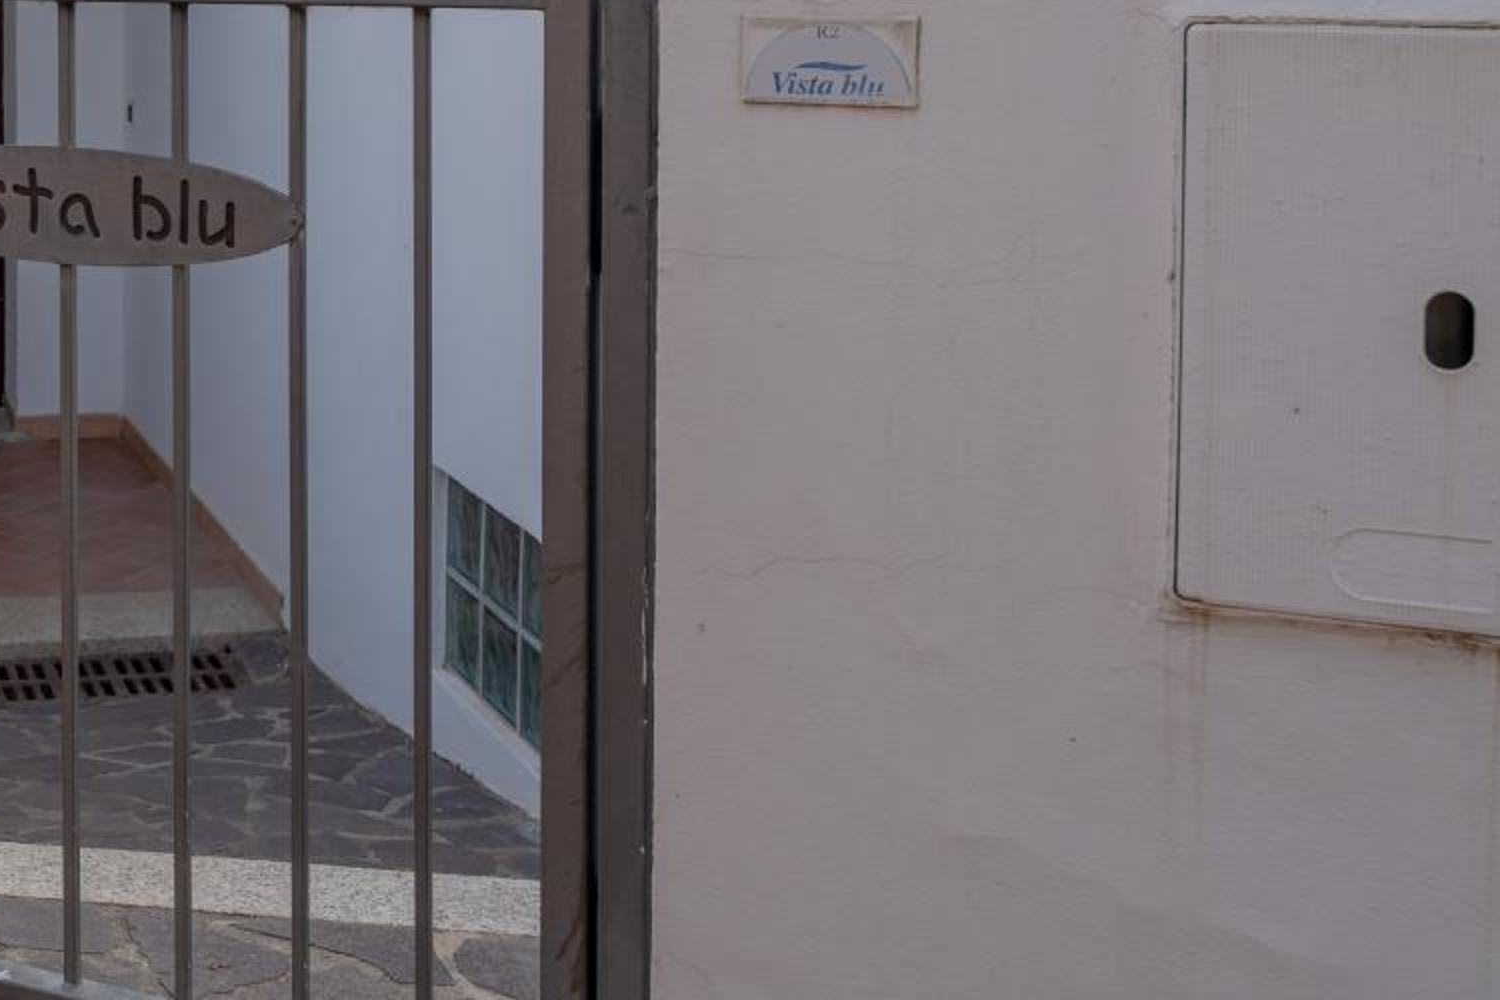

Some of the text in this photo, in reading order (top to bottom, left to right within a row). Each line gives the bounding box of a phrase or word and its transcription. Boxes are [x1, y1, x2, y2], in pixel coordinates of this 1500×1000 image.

[772, 71, 885, 96] Vista blu
[131, 175, 236, 248] blu
